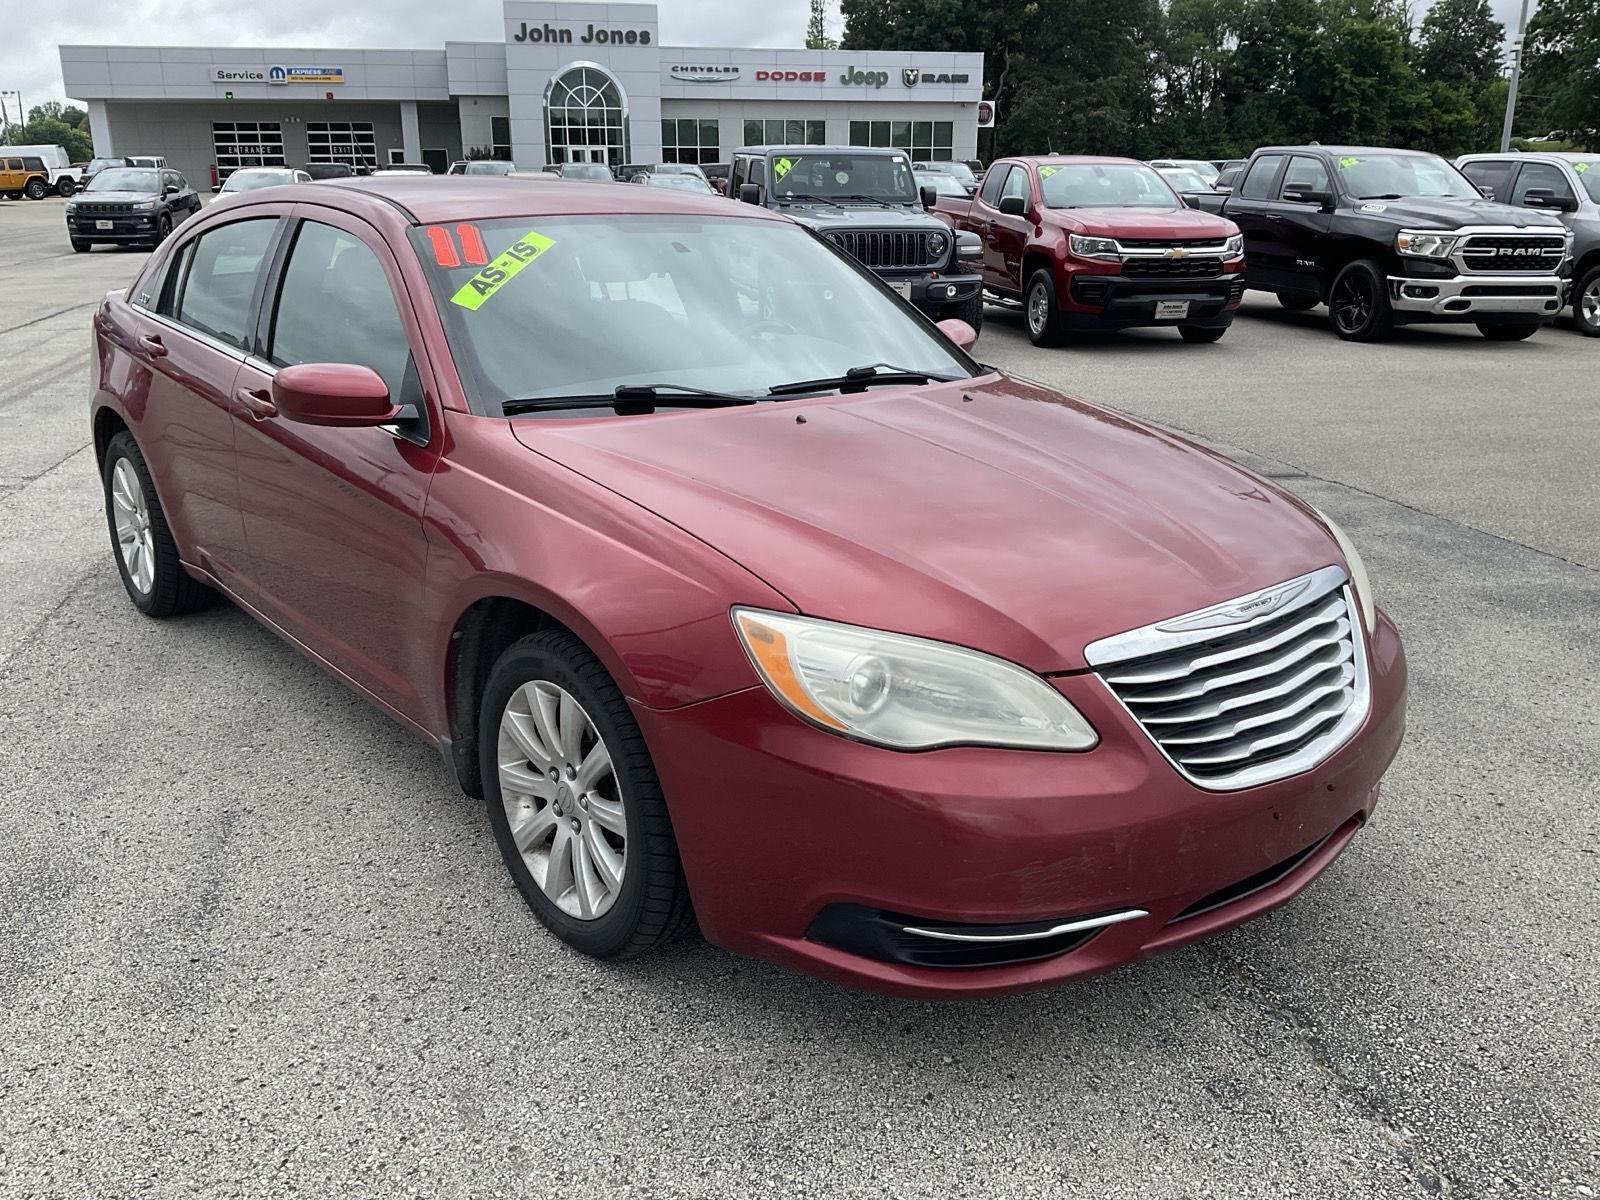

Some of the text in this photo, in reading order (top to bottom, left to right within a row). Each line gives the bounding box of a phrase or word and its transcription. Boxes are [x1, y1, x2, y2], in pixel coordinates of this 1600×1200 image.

[514, 22, 651, 45] John Jones
[671, 65, 740, 73] CHRYSLER
[217, 70, 264, 80] Service
[756, 71, 826, 82] DODGE
[839, 66, 889, 89] Jeep
[921, 73, 969, 84] RAM
[228, 146, 271, 154] ENTRANCE
[333, 146, 351, 154] EXIT
[427, 223, 489, 267] 11
[1498, 247, 1541, 256] RAM
